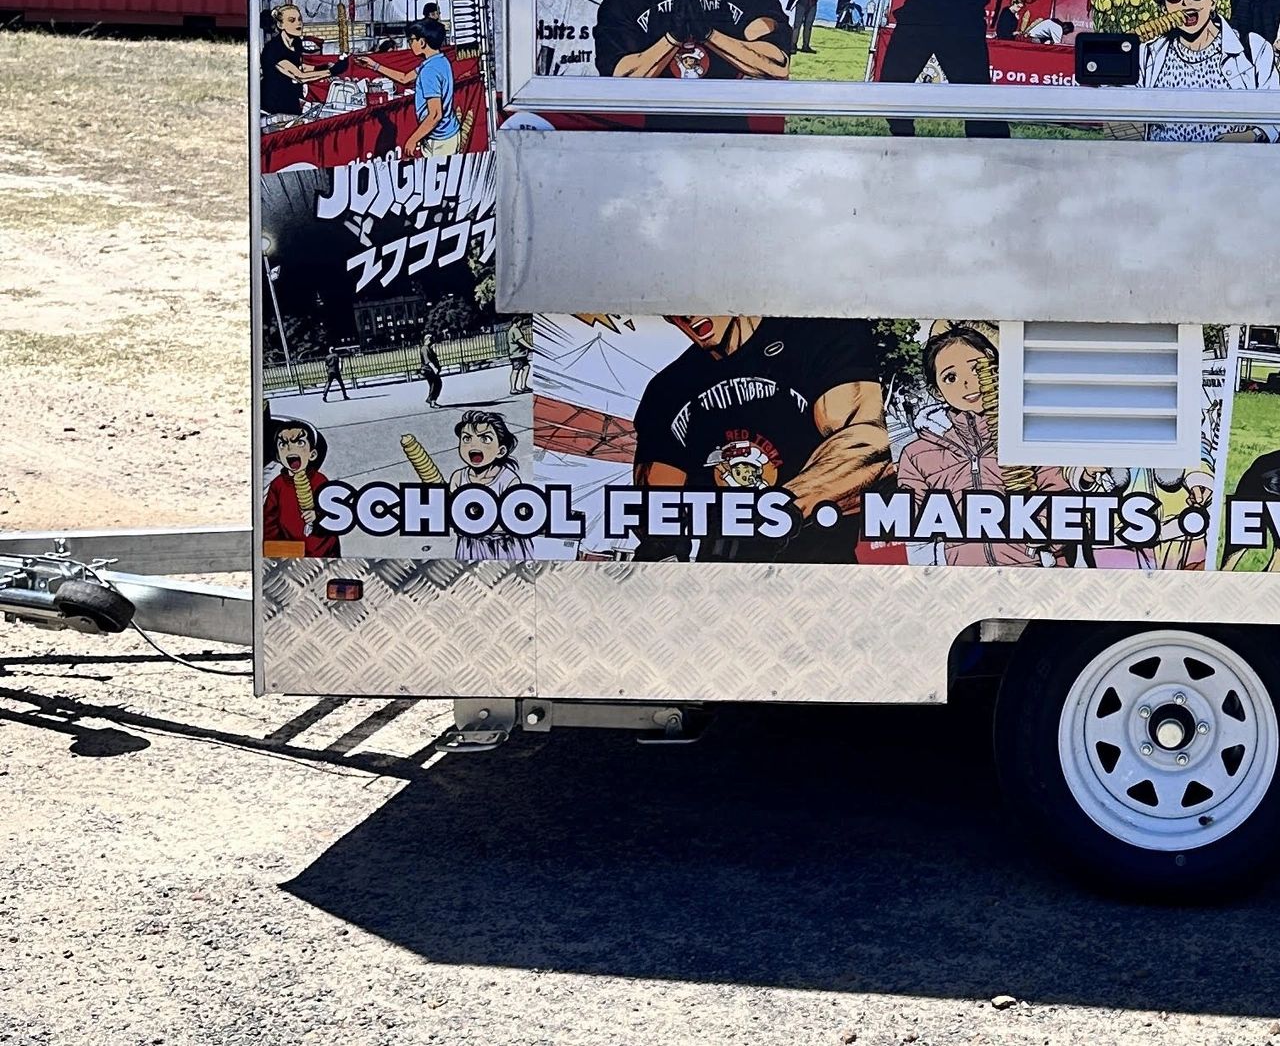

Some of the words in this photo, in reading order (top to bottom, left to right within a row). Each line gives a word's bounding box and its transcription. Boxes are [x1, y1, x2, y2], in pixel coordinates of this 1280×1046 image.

[1006, 71, 1026, 82] on
[1029, 73, 1040, 84] a
[319, 485, 581, 535] SCHOOL
[610, 490, 794, 538] FETES
[865, 492, 1157, 543] MARKETS
